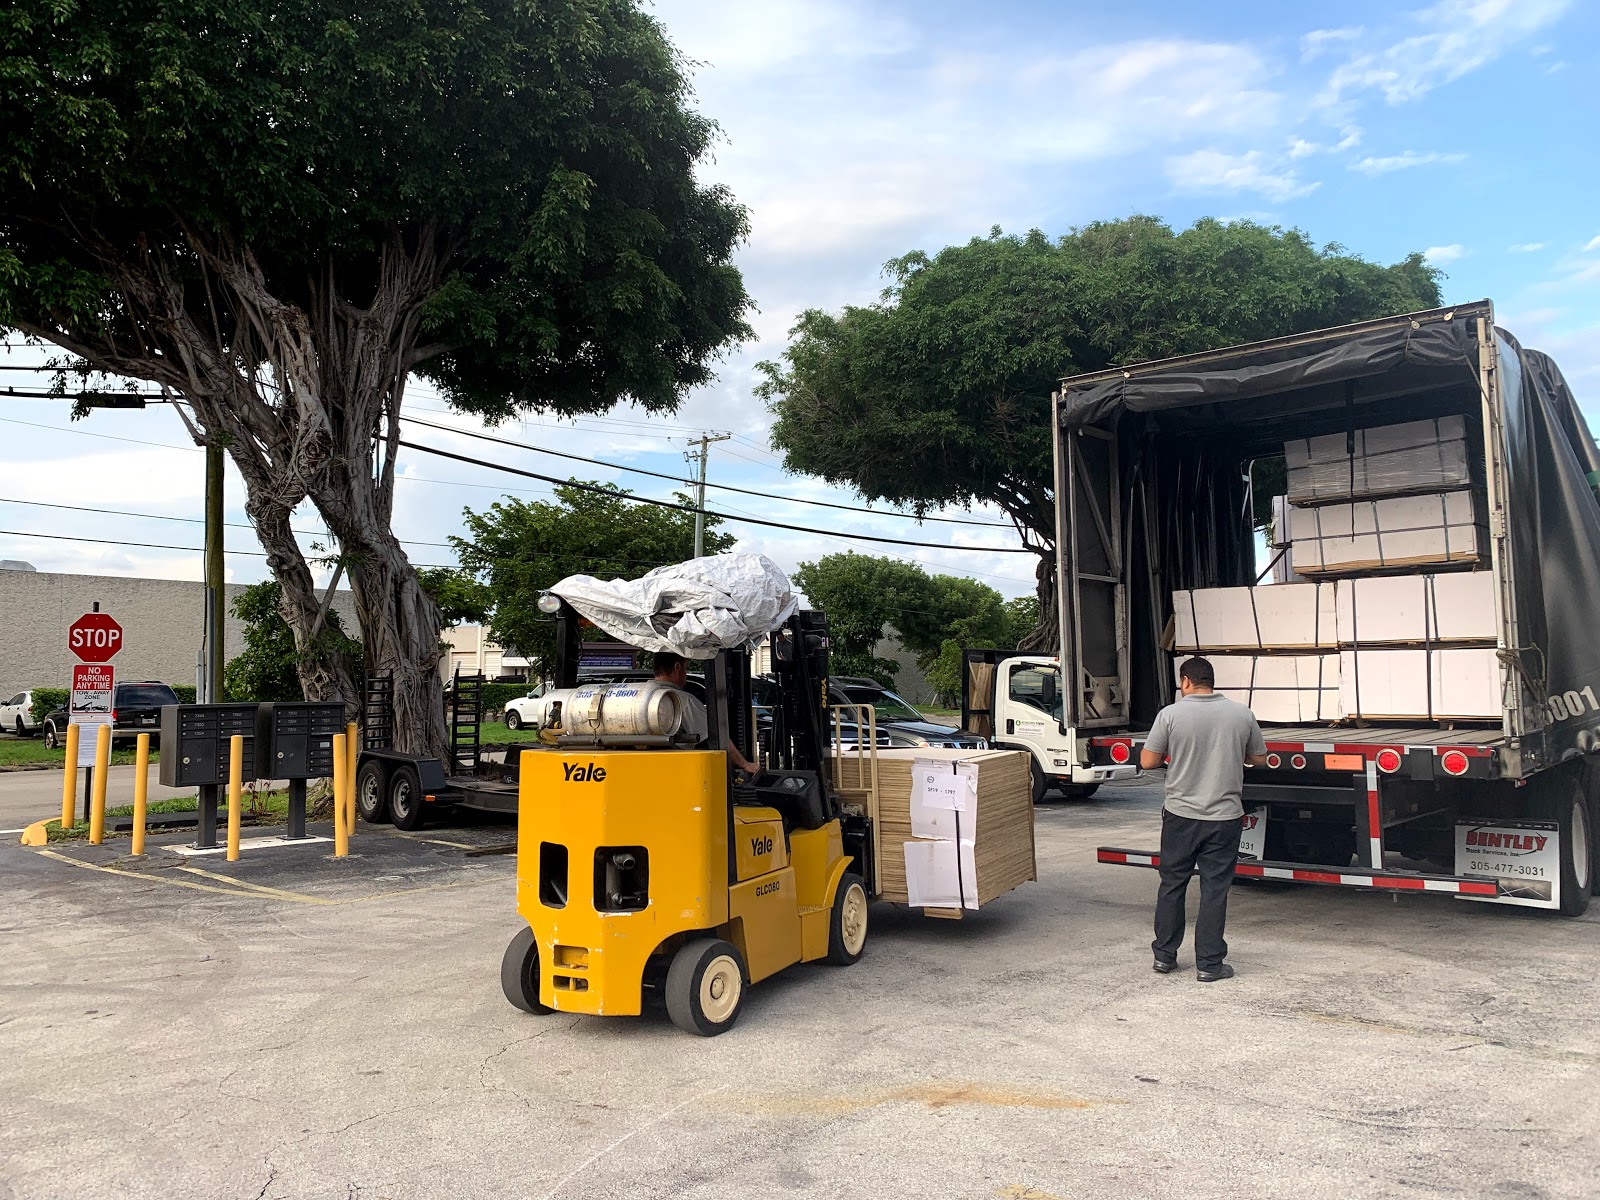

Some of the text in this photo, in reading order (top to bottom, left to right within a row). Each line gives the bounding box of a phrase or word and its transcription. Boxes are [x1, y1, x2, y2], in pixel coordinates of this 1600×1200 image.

[71, 628, 120, 648] STOP
[77, 674, 111, 682] PARKING
[88, 666, 101, 675] NO
[75, 681, 111, 690] ANY TIME
[820, 677, 828, 709] Yale
[562, 762, 607, 783] Yale
[750, 835, 773, 857] Yale
[1465, 830, 1549, 852] BENTLEY
[1482, 848, 1509, 857] Services,
[1470, 860, 1545, 877] 305-477-3031
[755, 881, 780, 897] GLC080
